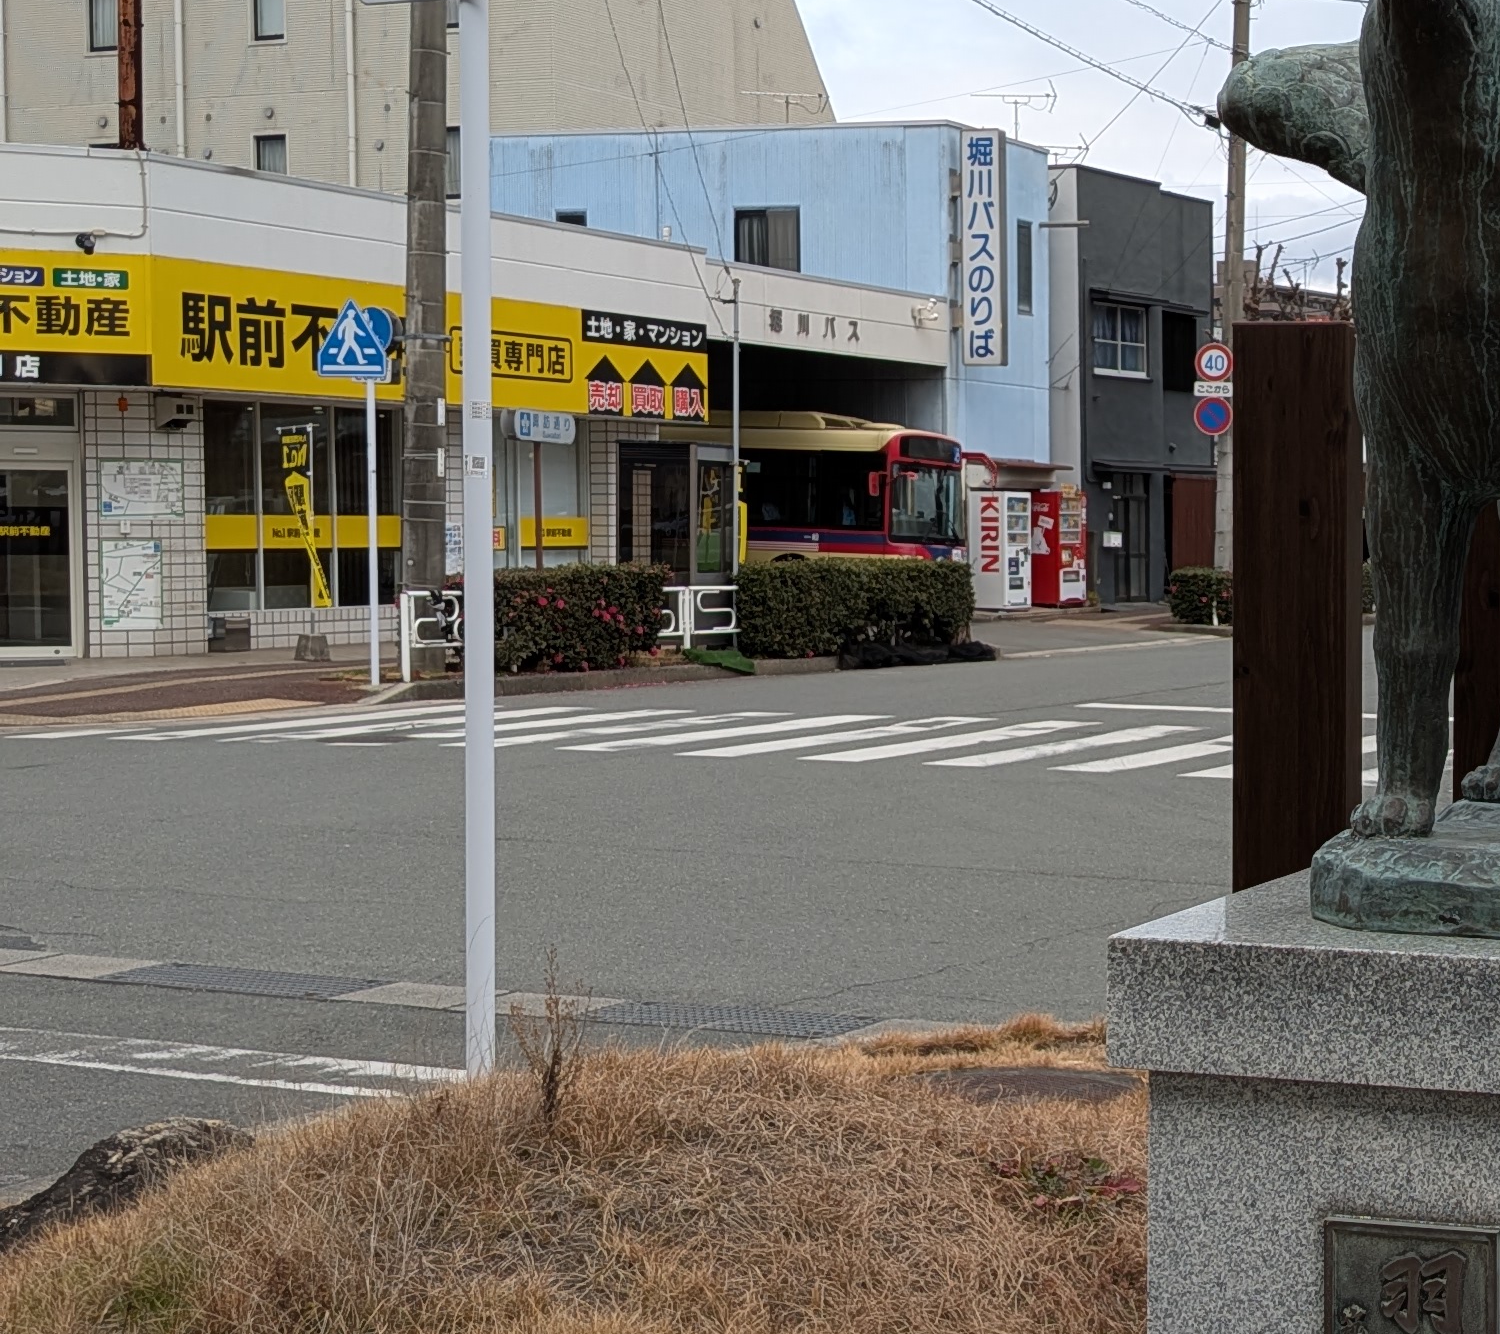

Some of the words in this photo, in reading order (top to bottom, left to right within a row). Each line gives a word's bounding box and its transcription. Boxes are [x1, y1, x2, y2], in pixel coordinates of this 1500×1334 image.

[967, 137, 995, 358] 堀川バスのりば
[587, 316, 703, 348] 土地・家・マンション
[1204, 354, 1225, 371] 40
[588, 380, 623, 412] 売却
[631, 384, 665, 415] 買取
[674, 387, 706, 417] 購入
[1197, 384, 1230, 394] ここから
[980, 496, 1000, 573] KIRIN
